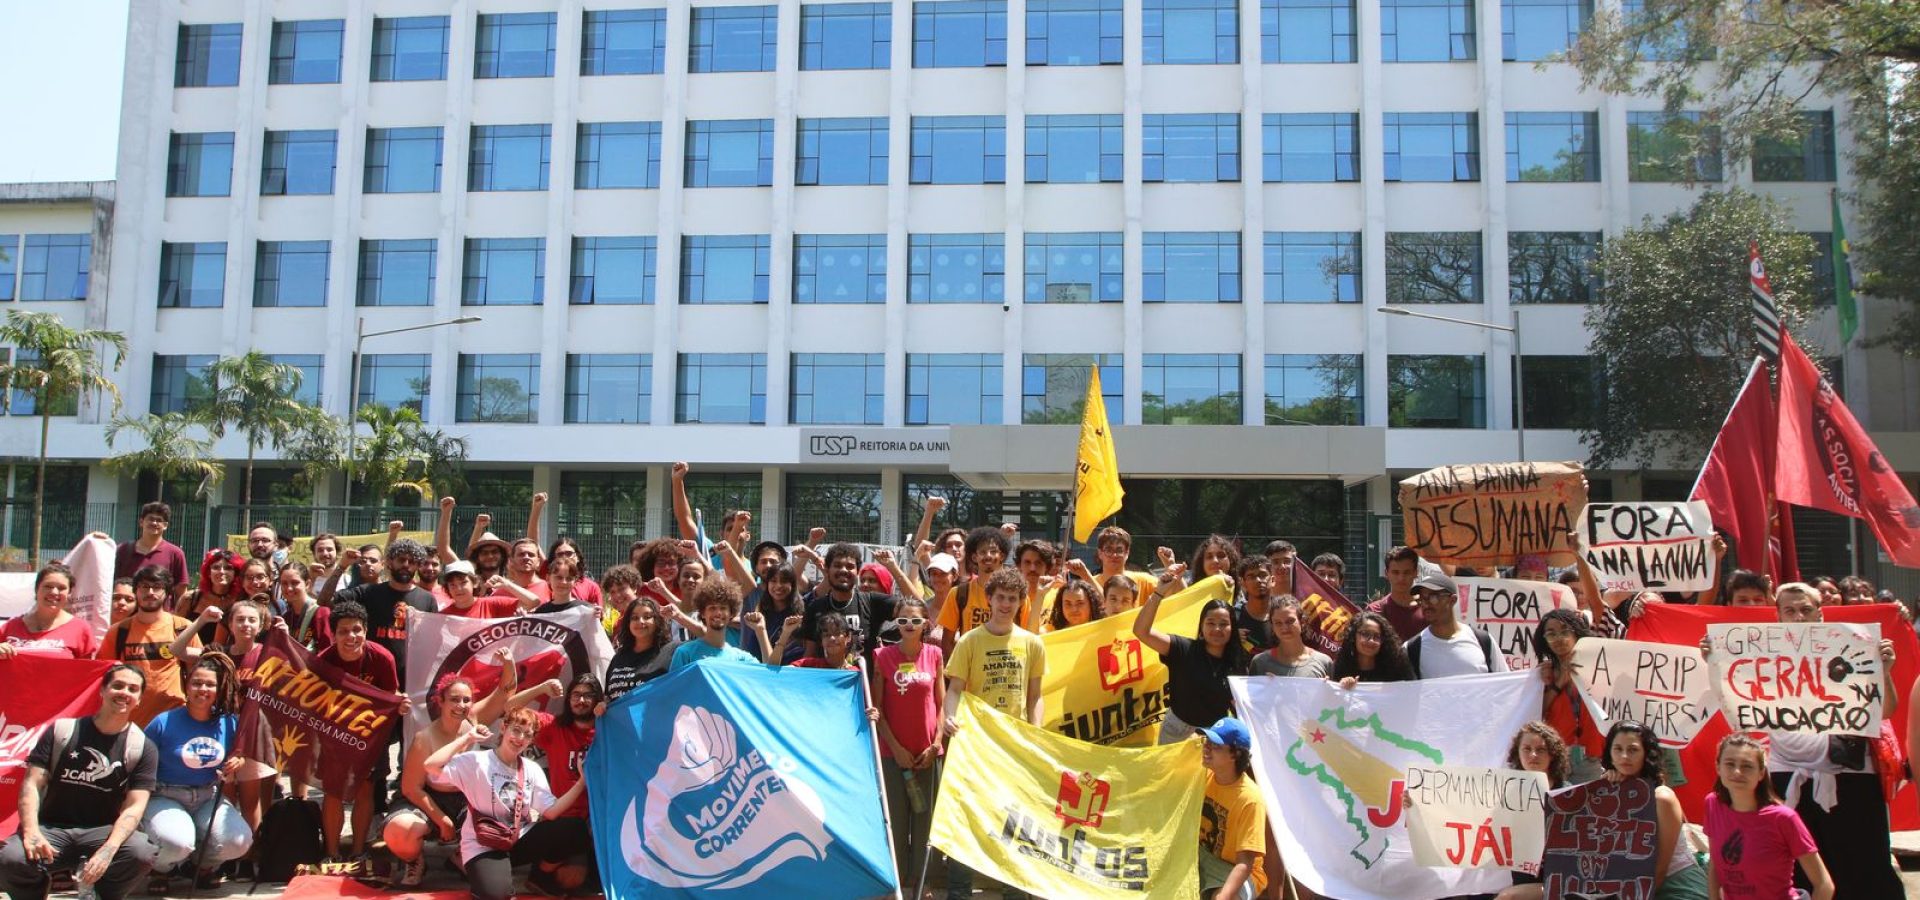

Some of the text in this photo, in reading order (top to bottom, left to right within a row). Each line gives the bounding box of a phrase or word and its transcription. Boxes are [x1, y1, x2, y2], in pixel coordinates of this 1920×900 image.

[811, 435, 857, 455] USP
[860, 442, 906, 451] REITORIA
[909, 442, 924, 451] DA
[1416, 463, 1541, 500] ANA LANNA
[1410, 497, 1575, 558] DESUMANA
[1587, 504, 1694, 545] FORA
[1586, 539, 1708, 588] ANA LANNA
[1475, 585, 1541, 620] FORA
[467, 620, 569, 652] GEOGRAFIA
[1500, 624, 1538, 658] LAN
[1726, 626, 1826, 655] GREVE
[1506, 657, 1531, 672] ACH
[1592, 646, 1697, 692] A PRIP
[1728, 656, 1882, 704] GERAL NA
[253, 656, 388, 737] AFRONTE!
[1602, 697, 1633, 720] UMA
[307, 716, 331, 735] SEM
[332, 728, 367, 751] MEDO
[1738, 702, 1871, 733] EDUCAÇÃO
[1407, 768, 1546, 812] PERMANÊNCIA
[1548, 778, 1650, 820] USP
[1446, 818, 1514, 867] JÁ!
[1545, 813, 1657, 860] LESTE
